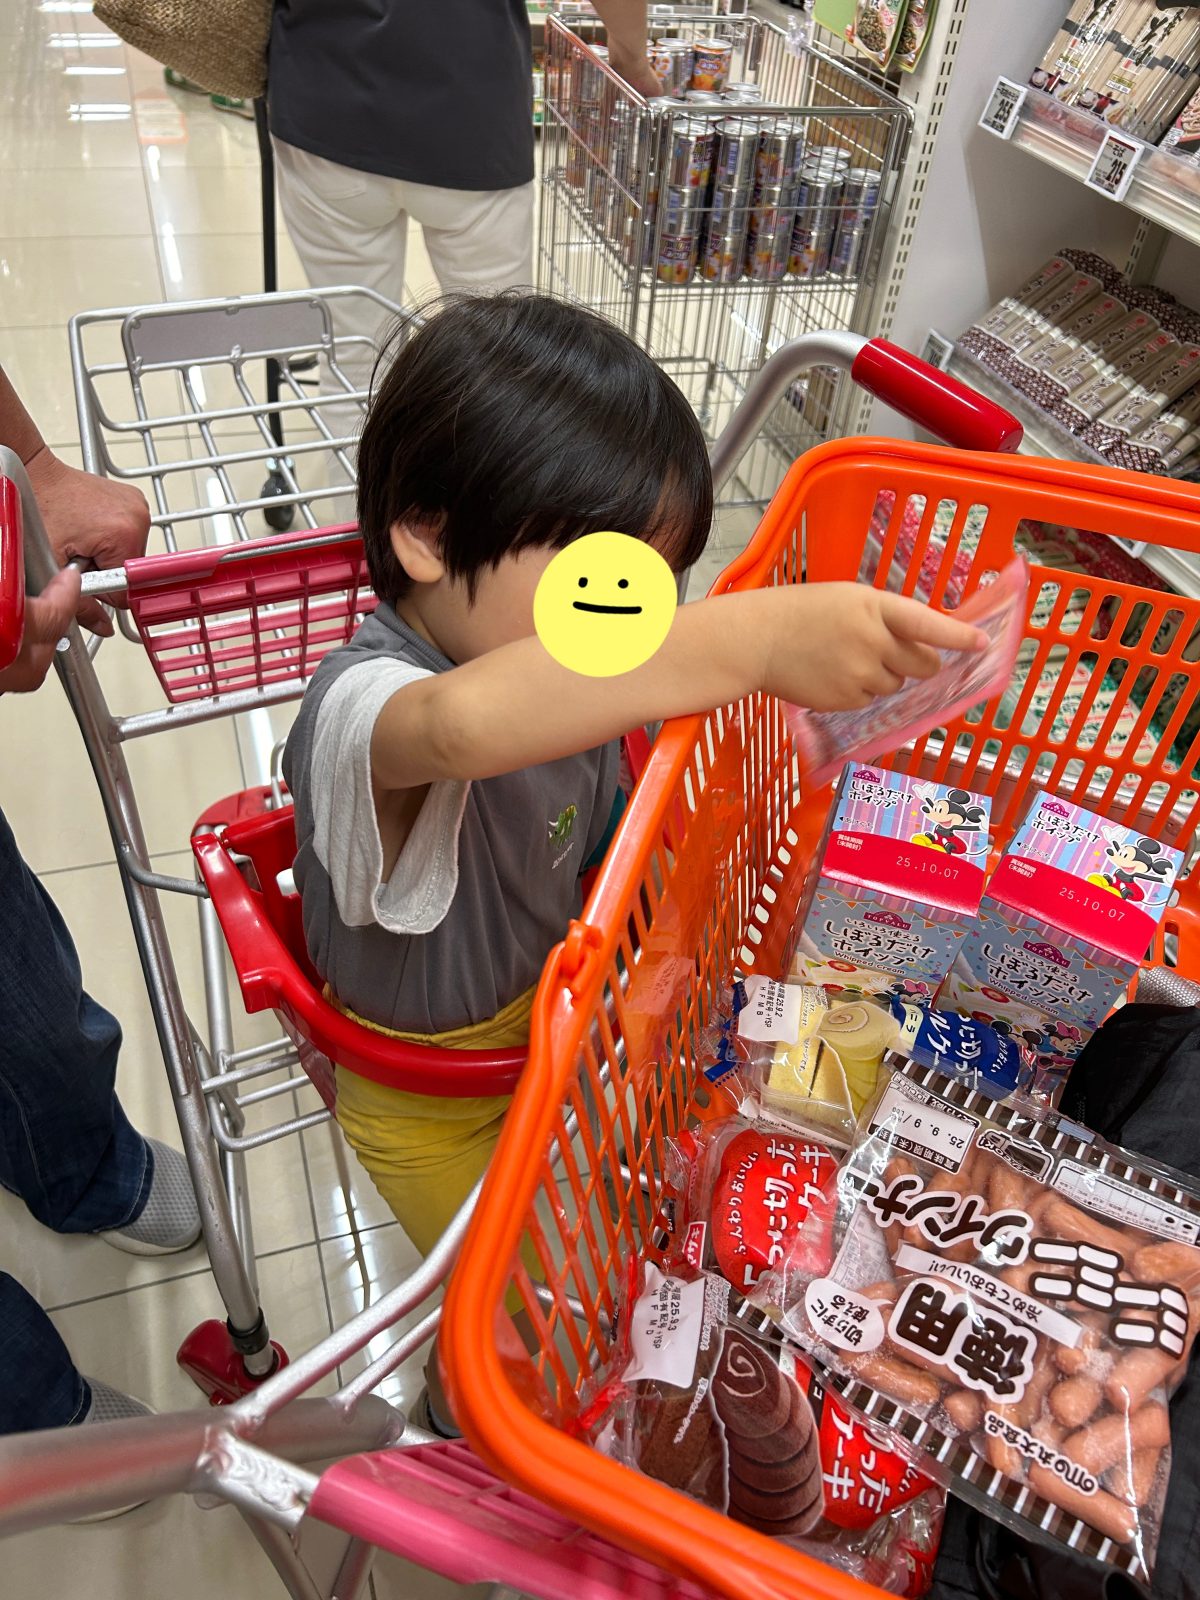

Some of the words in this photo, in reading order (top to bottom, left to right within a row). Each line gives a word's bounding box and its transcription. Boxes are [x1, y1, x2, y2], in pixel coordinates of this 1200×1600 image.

[994, 98, 1015, 124] 255
[1112, 143, 1126, 157] そば
[1105, 158, 1128, 186] 215
[849, 790, 898, 808] ホイップ
[851, 780, 915, 804] しぼるだけ
[837, 834, 864, 846] 賞味期限
[1031, 819, 1082, 843] ホイップ
[1037, 810, 1101, 844] しぼるだけ
[836, 841, 862, 852] (未開封)
[896, 855, 960, 880] 25.10.07
[1008, 864, 1034, 878] (未開封)
[1010, 858, 1037, 874] 賞味期限
[1058, 886, 1126, 921] 25.10.07
[845, 917, 922, 943] いろいろ使える
[866, 914, 910, 930] TOPVALU
[825, 920, 935, 959] しぼるだけ
[833, 938, 915, 966] ホイップ
[834, 951, 874, 967] Whipped
[1005, 943, 1079, 983] いろいろ使える
[1026, 943, 1068, 966] TOPVALU
[983, 944, 1092, 1003] しぼるだけ
[988, 963, 1070, 1004] ホイップ
[989, 977, 1029, 1001] Whipped
[727, 1151, 760, 1255] ふんわりおいしい
[686, 1227, 701, 1265] マザキ
[928, 1258, 1044, 1324] 冷めてもおいしい!
[811, 1298, 863, 1346] 切らずに
[832, 1293, 870, 1324] 使える
[895, 1282, 1030, 1396] 徳用
[987, 1413, 1057, 1465] 丸大食品
